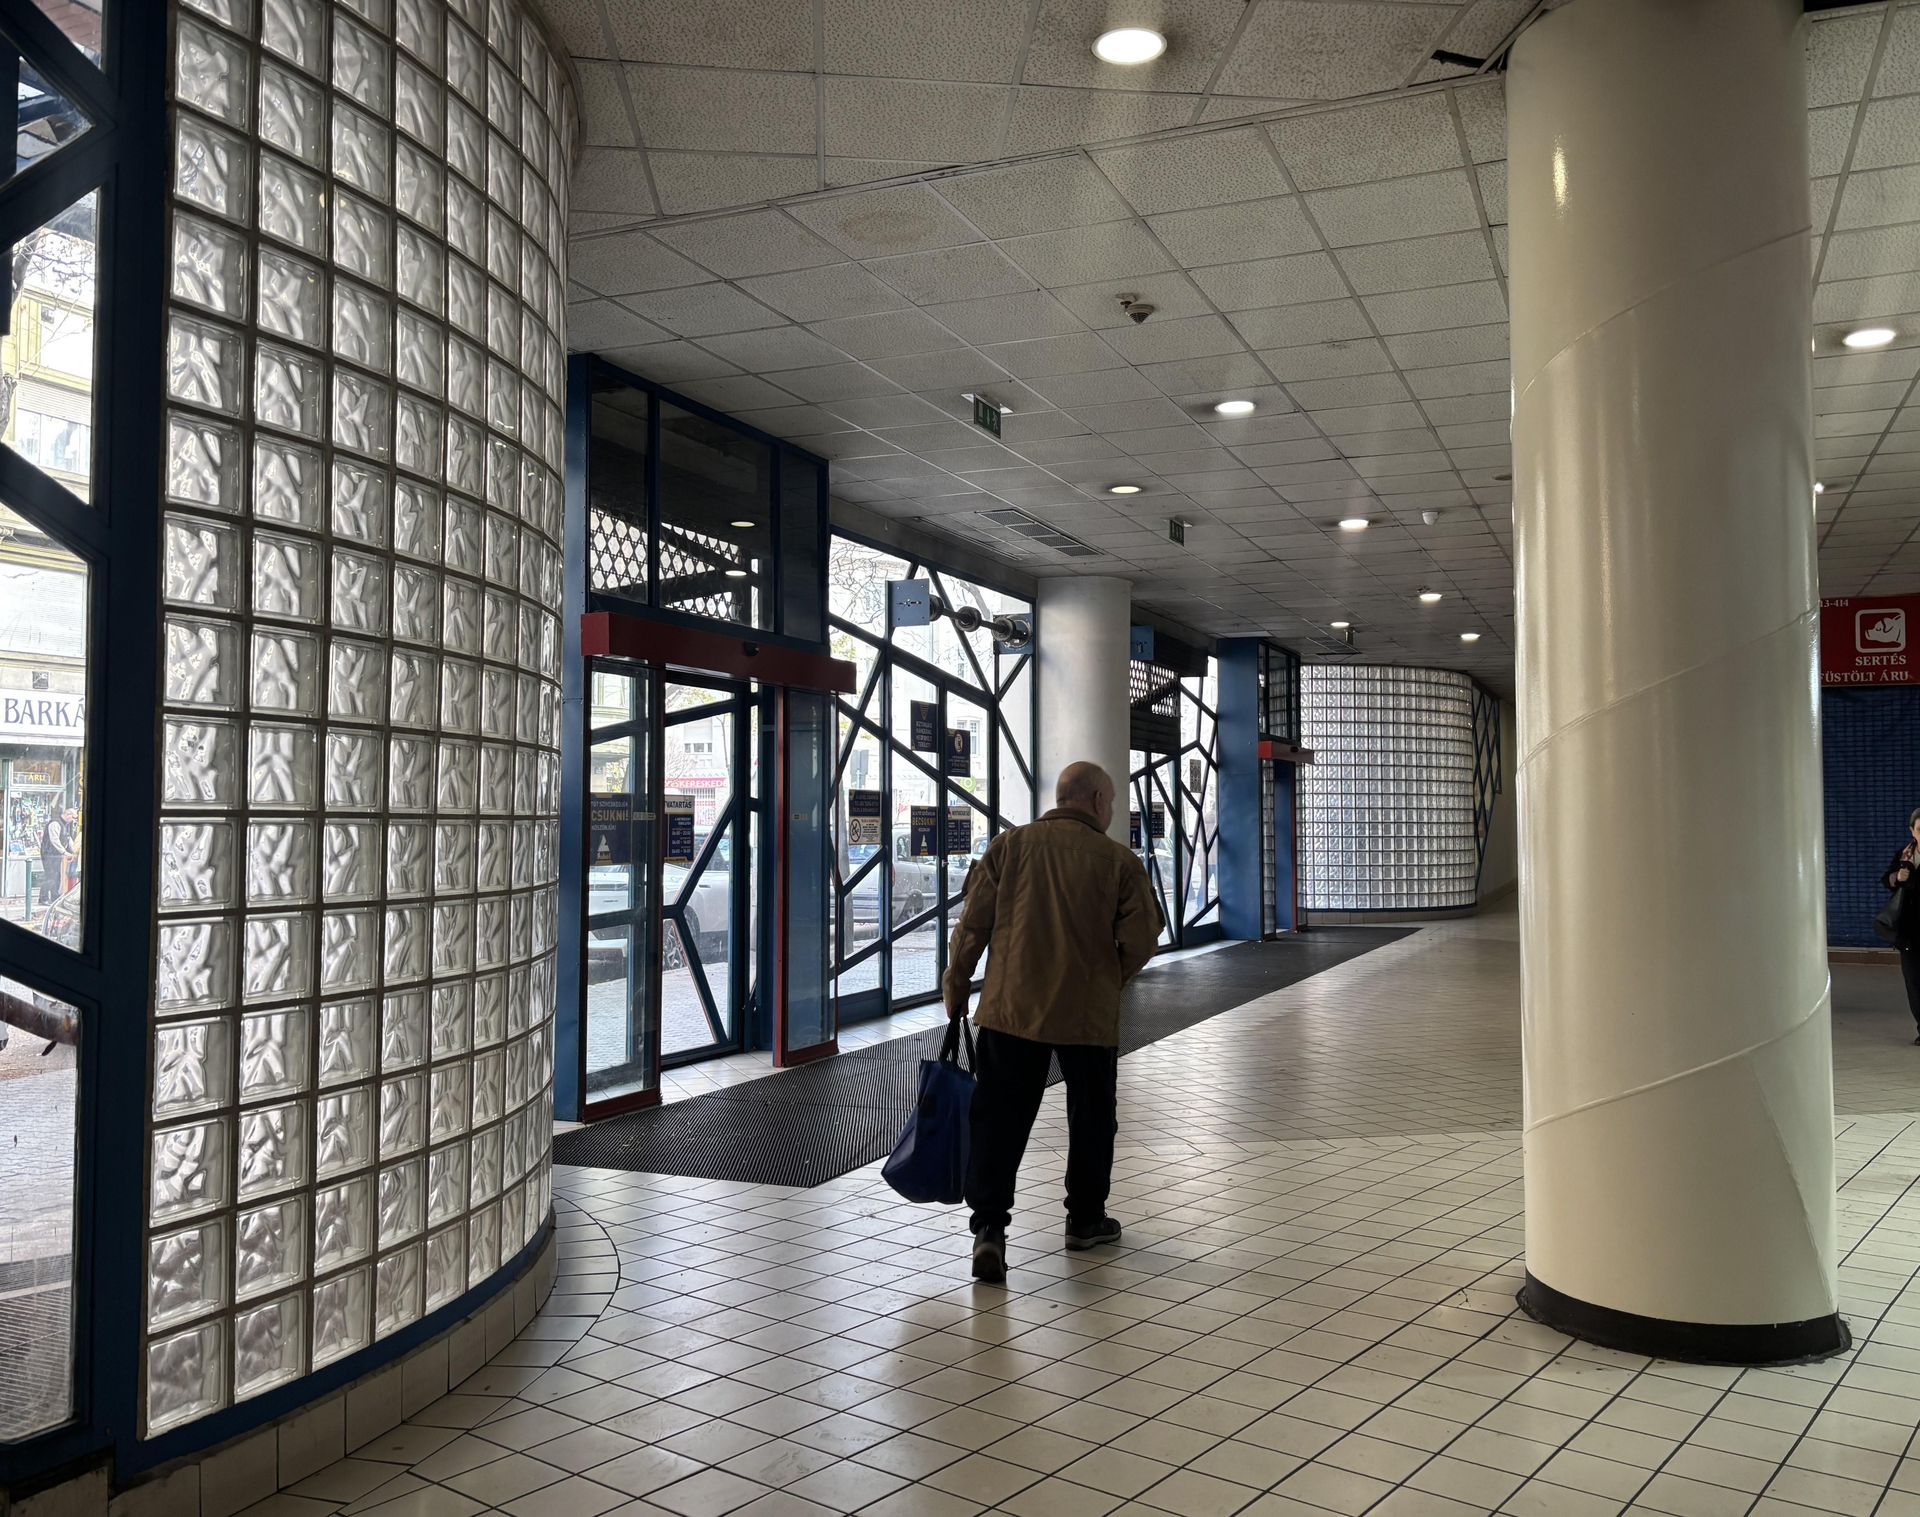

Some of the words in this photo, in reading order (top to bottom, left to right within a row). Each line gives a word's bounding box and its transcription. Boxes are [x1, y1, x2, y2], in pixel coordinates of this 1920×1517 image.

[1855, 653, 1906, 666] SERTÉS
[1879, 669, 1909, 682] ÁRU
[4, 697, 85, 727] BARKÁ
